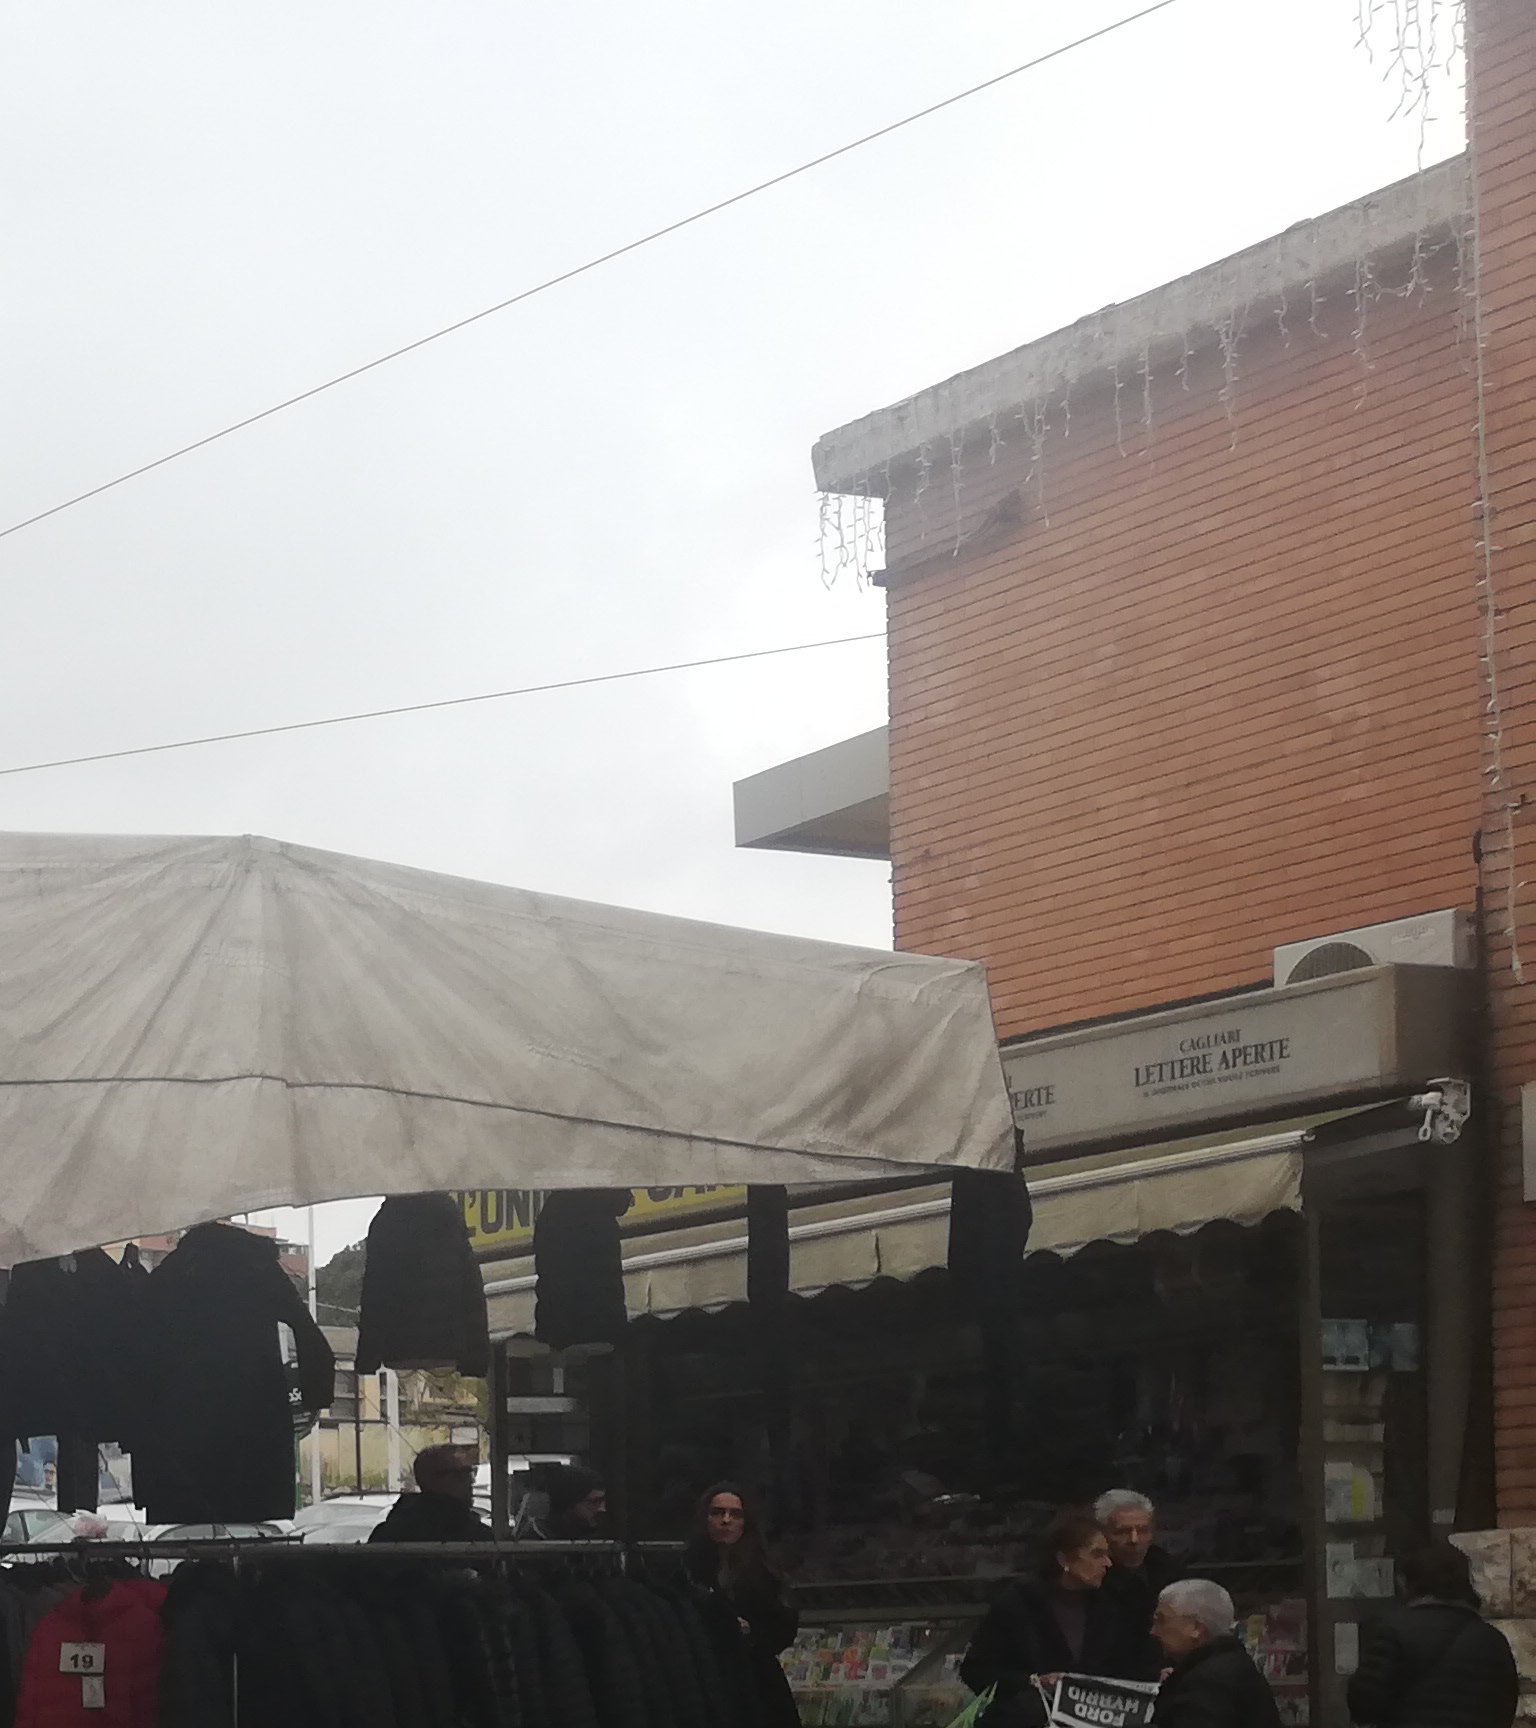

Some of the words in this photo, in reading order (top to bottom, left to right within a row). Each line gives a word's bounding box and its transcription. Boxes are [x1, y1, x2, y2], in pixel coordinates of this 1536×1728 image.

[1179, 1028, 1242, 1053] CAGLIARI
[1134, 1052, 1214, 1087] LETTERE
[1217, 1037, 1291, 1072] APERTE
[69, 1653, 94, 1669] 19
[1074, 1702, 1126, 1728] FORD
